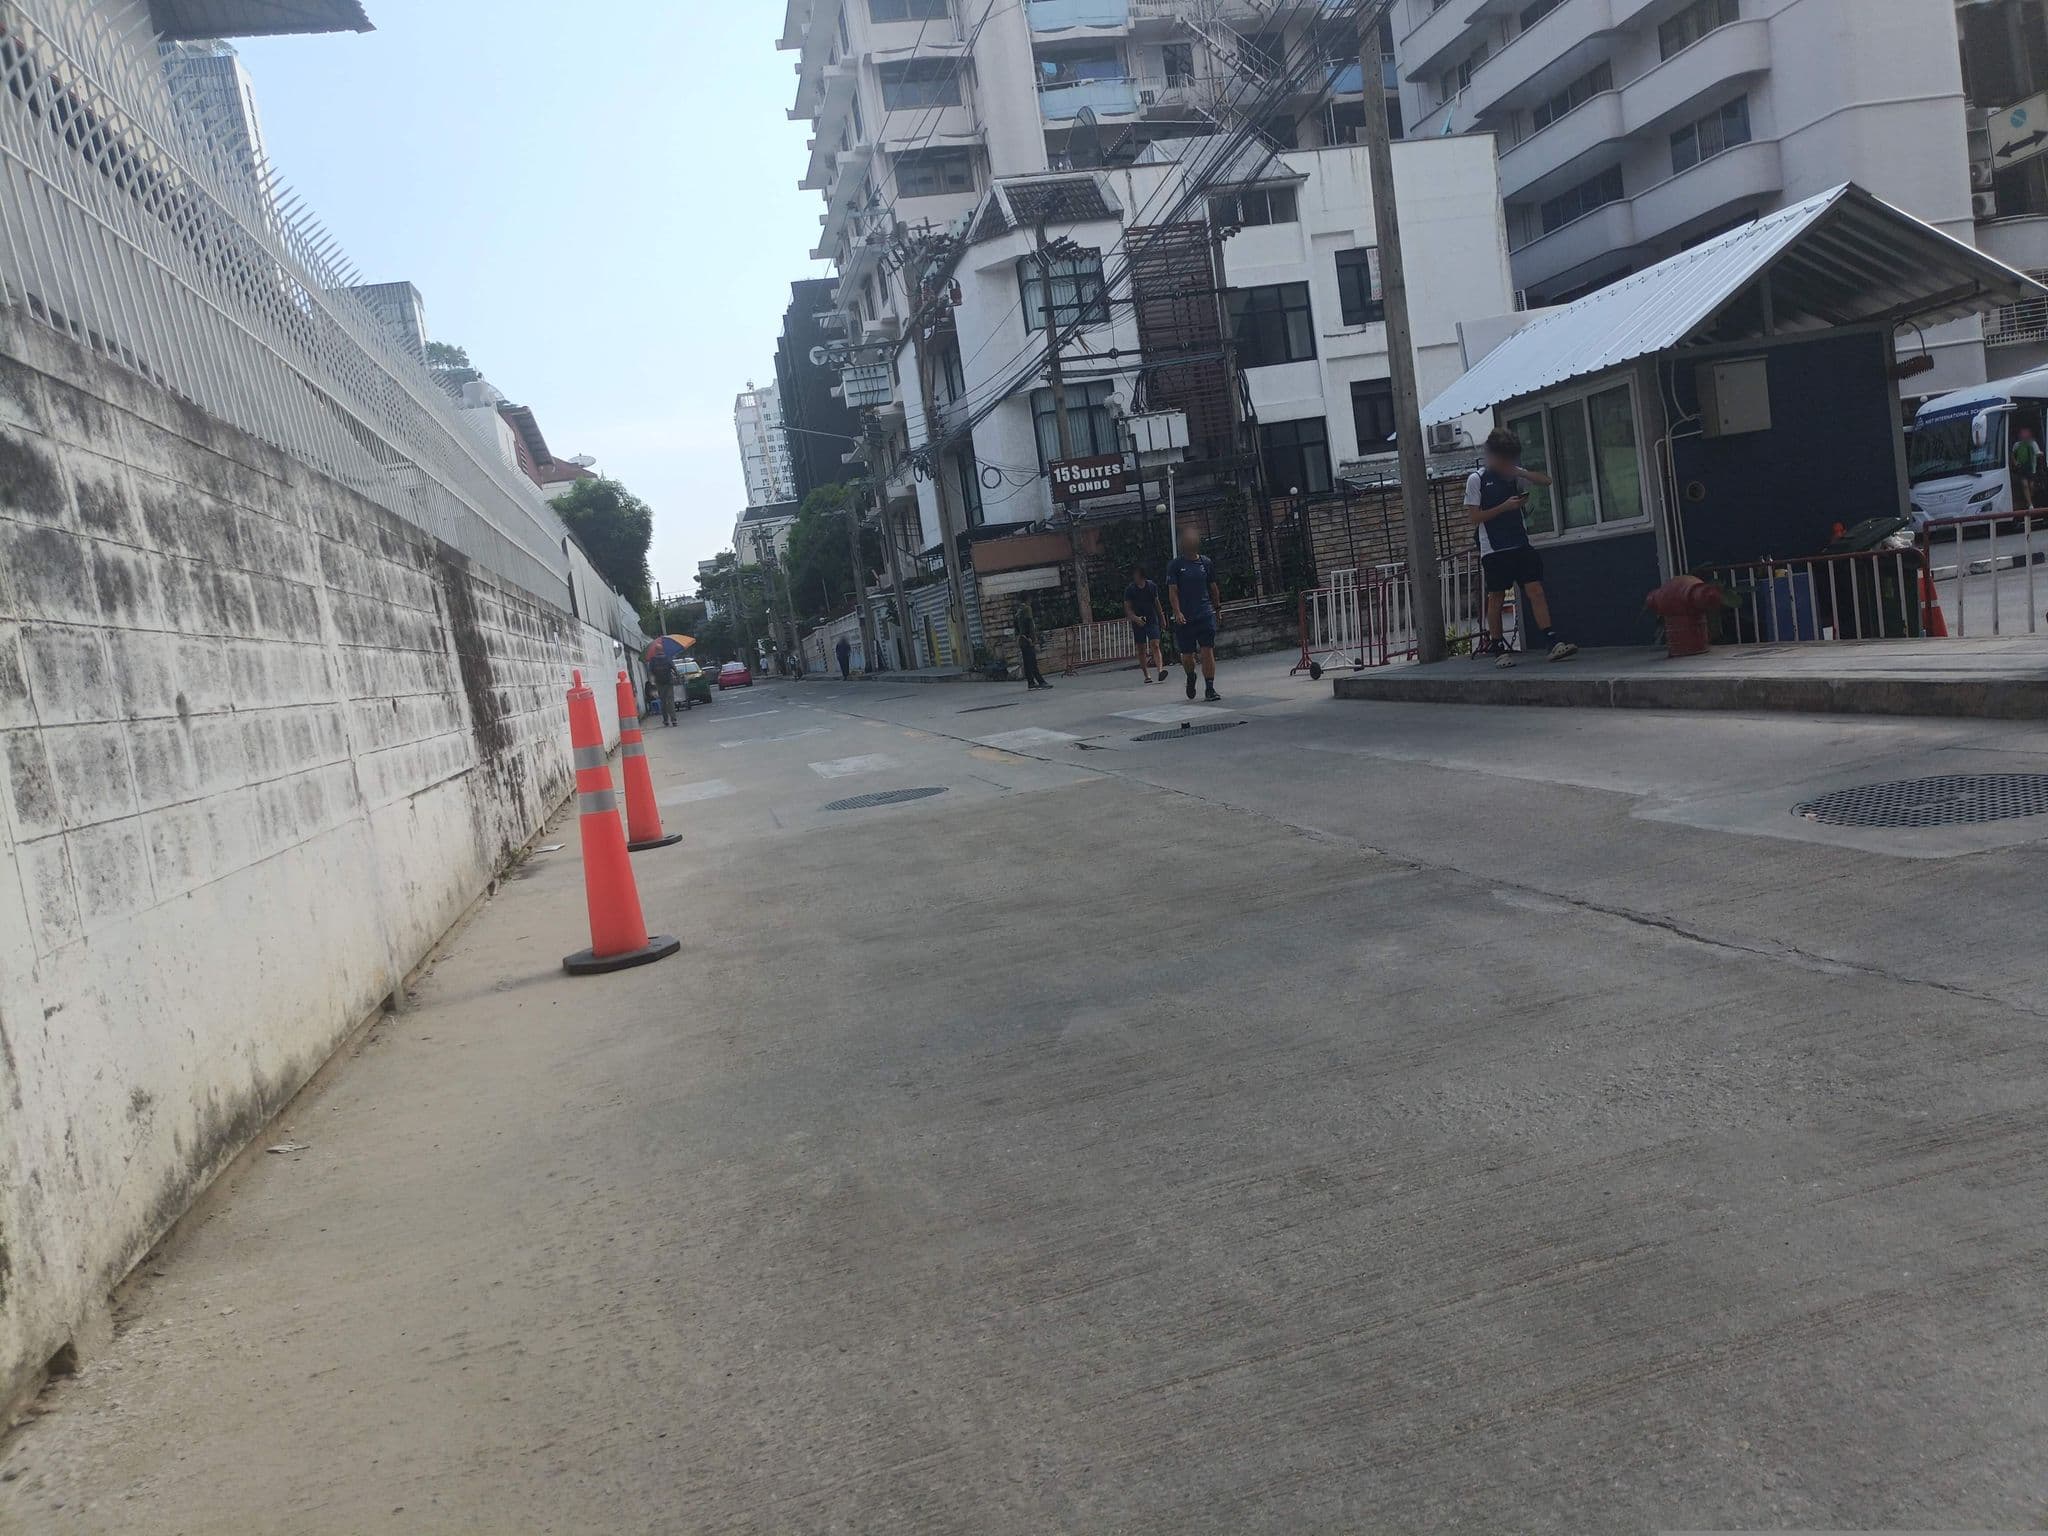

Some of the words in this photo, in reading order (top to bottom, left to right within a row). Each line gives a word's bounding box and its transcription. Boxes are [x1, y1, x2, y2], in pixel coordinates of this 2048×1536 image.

[1053, 466, 1071, 482] 15
[1071, 464, 1121, 480] SUITES
[1069, 480, 1110, 493] CONDO
